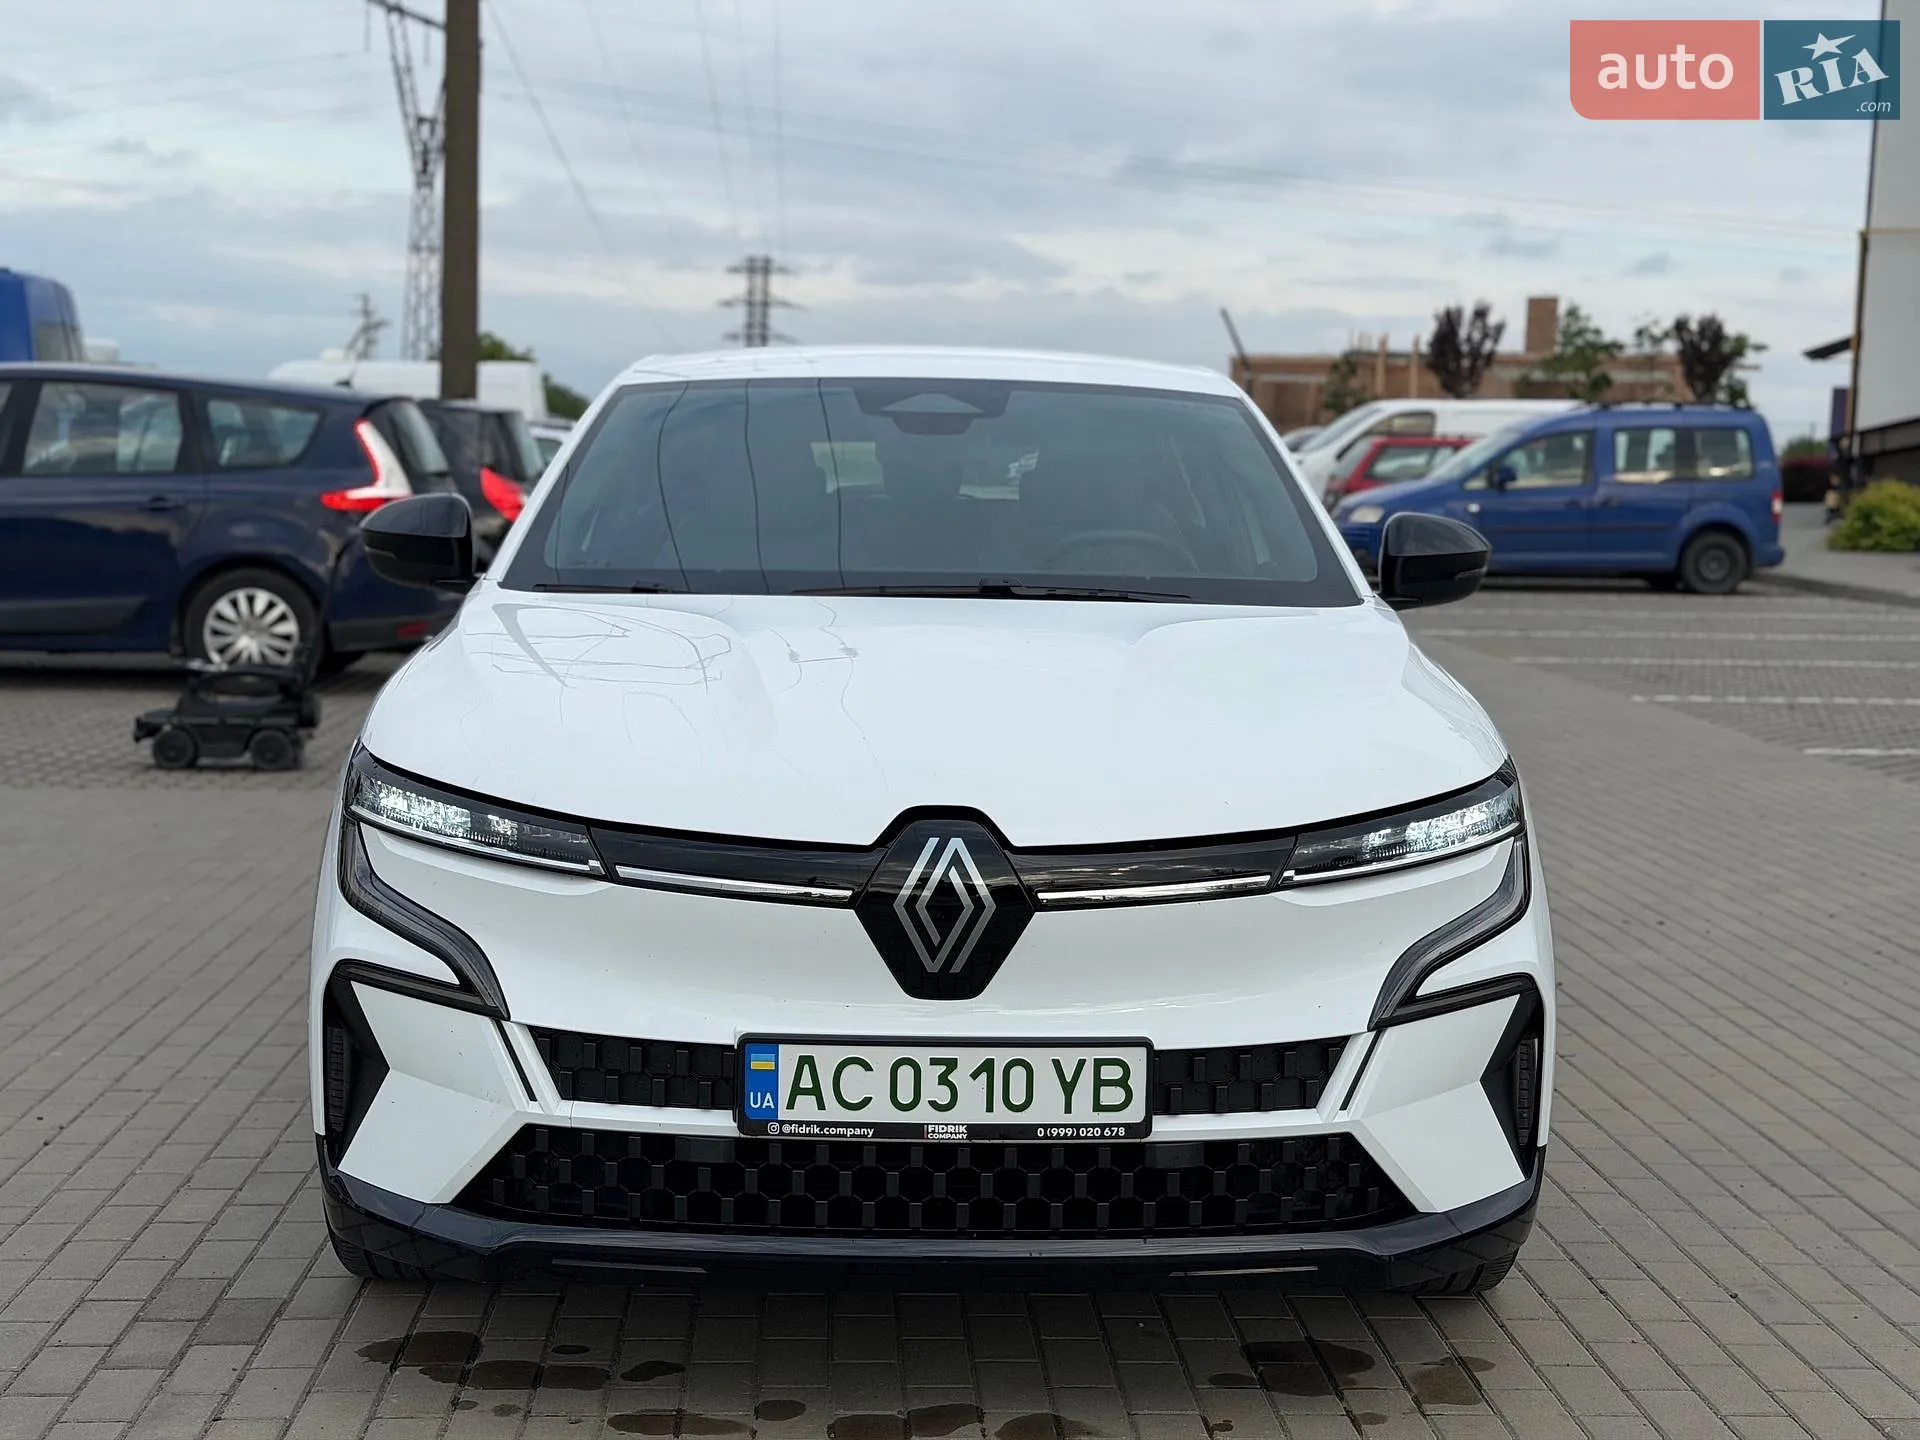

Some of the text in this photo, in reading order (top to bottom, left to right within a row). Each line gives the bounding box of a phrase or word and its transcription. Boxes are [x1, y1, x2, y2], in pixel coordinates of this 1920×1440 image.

[785, 1054, 1133, 1114] AC 0310 YB
[749, 1091, 775, 1109] UA
[782, 1124, 874, 1138] @fidrik.company
[927, 1124, 968, 1133] FIDRIK
[1037, 1126, 1125, 1137] 0 (999) 020 678
